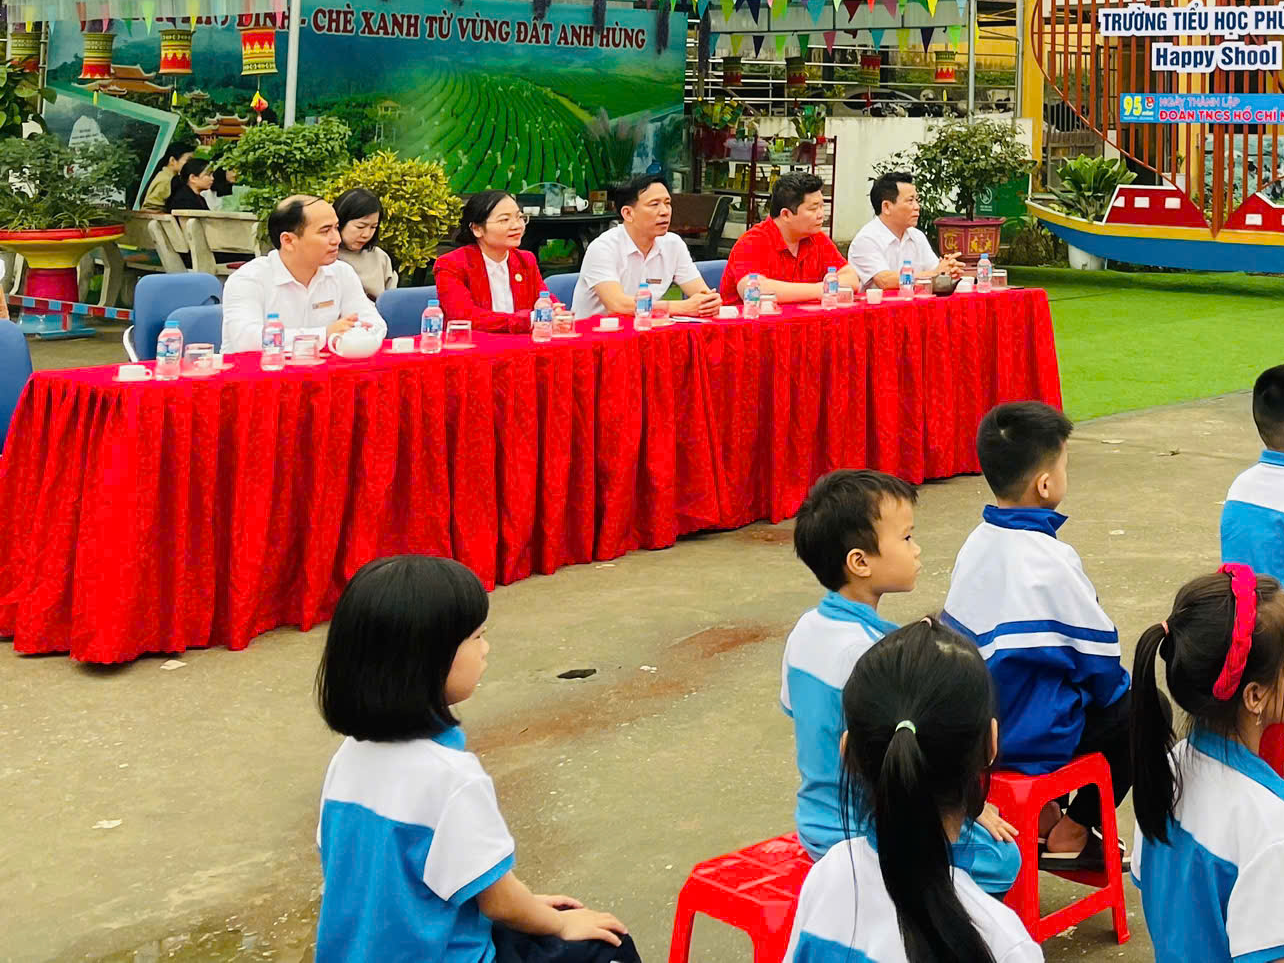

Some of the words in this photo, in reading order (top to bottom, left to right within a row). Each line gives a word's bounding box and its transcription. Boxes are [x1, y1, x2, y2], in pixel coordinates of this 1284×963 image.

[313, 3, 355, 33] CHÈ
[360, 12, 419, 37] XANH
[425, 10, 453, 38] TỪ
[457, 13, 510, 41] VÙNG
[557, 25, 594, 46] ANH
[598, 21, 646, 48] HÙNG
[1103, 6, 1167, 31] TRƯỜNG
[1173, 2, 1208, 31] TIỂU
[1214, 11, 1248, 35] HỌC
[1156, 47, 1214, 68] Happy
[1221, 46, 1277, 65] Shool
[1123, 96, 1142, 115] 95
[1199, 110, 1230, 120] TNCS
